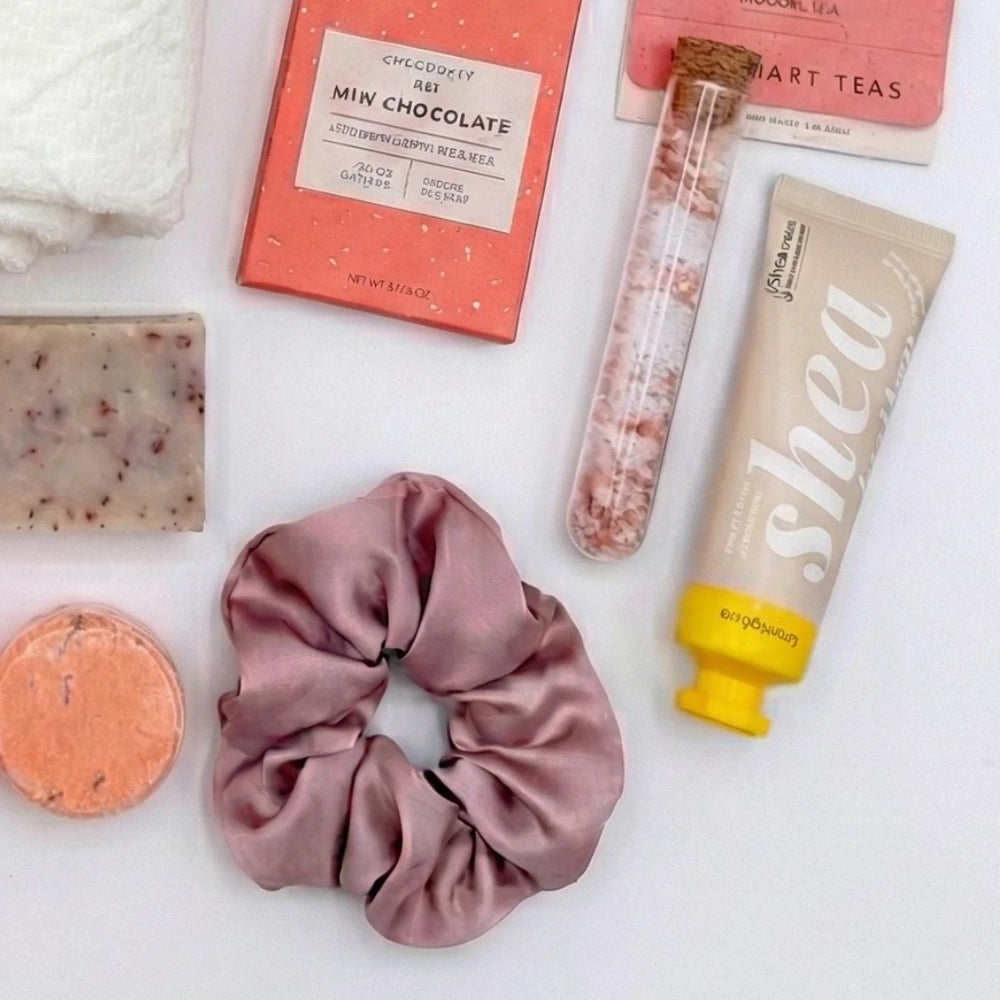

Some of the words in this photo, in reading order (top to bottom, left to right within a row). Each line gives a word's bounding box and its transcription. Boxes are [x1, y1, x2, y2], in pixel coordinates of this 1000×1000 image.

[834, 74, 902, 101] TEAS
[382, 95, 512, 135] CHOCOLATE
[747, 284, 893, 584] shea
